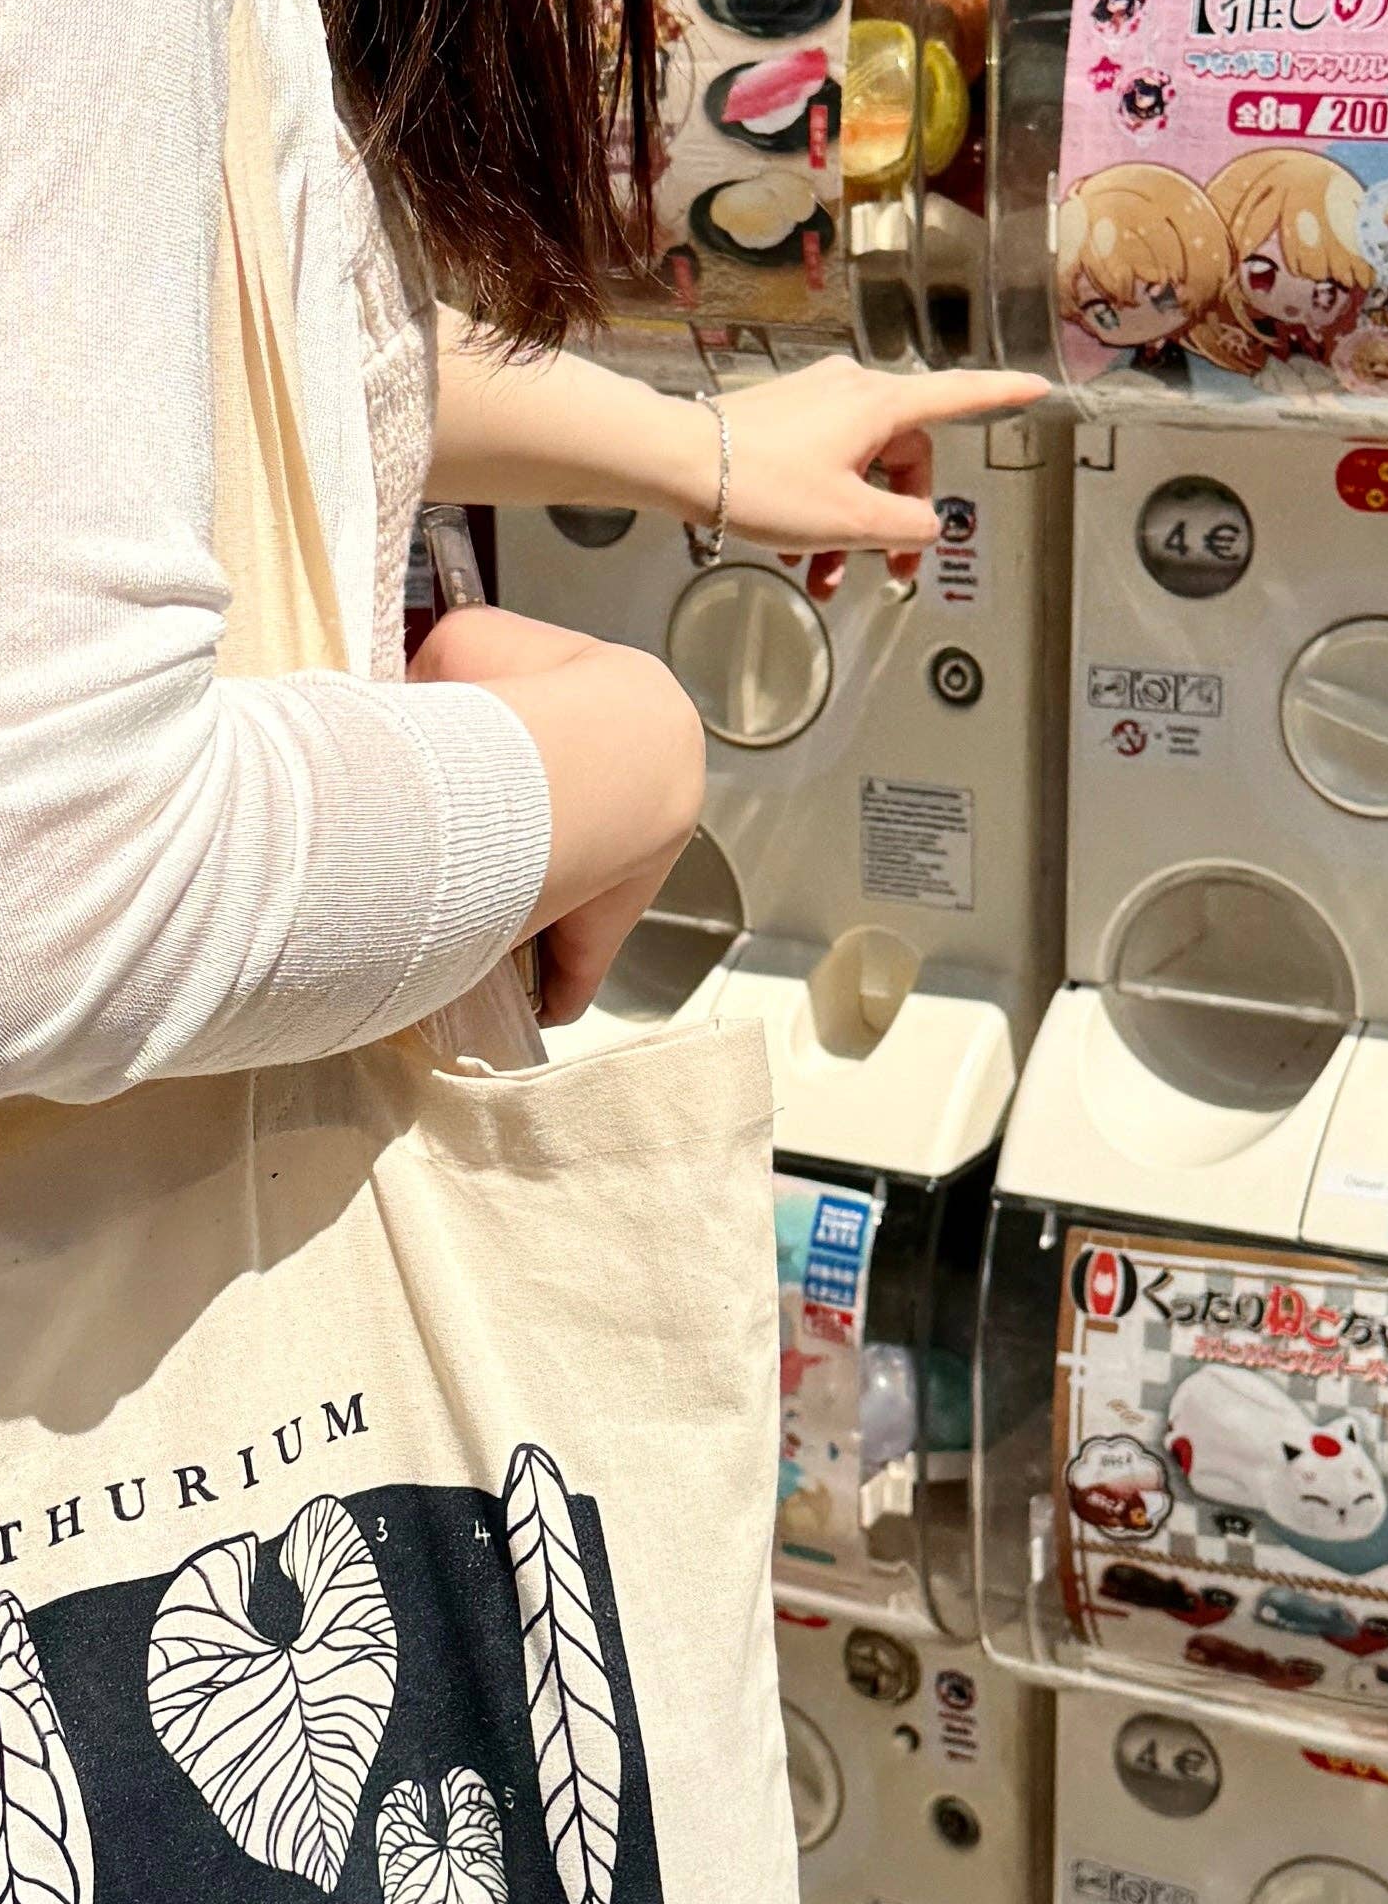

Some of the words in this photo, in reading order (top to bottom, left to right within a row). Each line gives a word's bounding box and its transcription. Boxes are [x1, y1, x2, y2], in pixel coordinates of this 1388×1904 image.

[1164, 521, 1188, 557] 4
[1204, 522, 1241, 562] €
[376, 1516, 389, 1543] 3
[474, 1520, 492, 1547] 4
